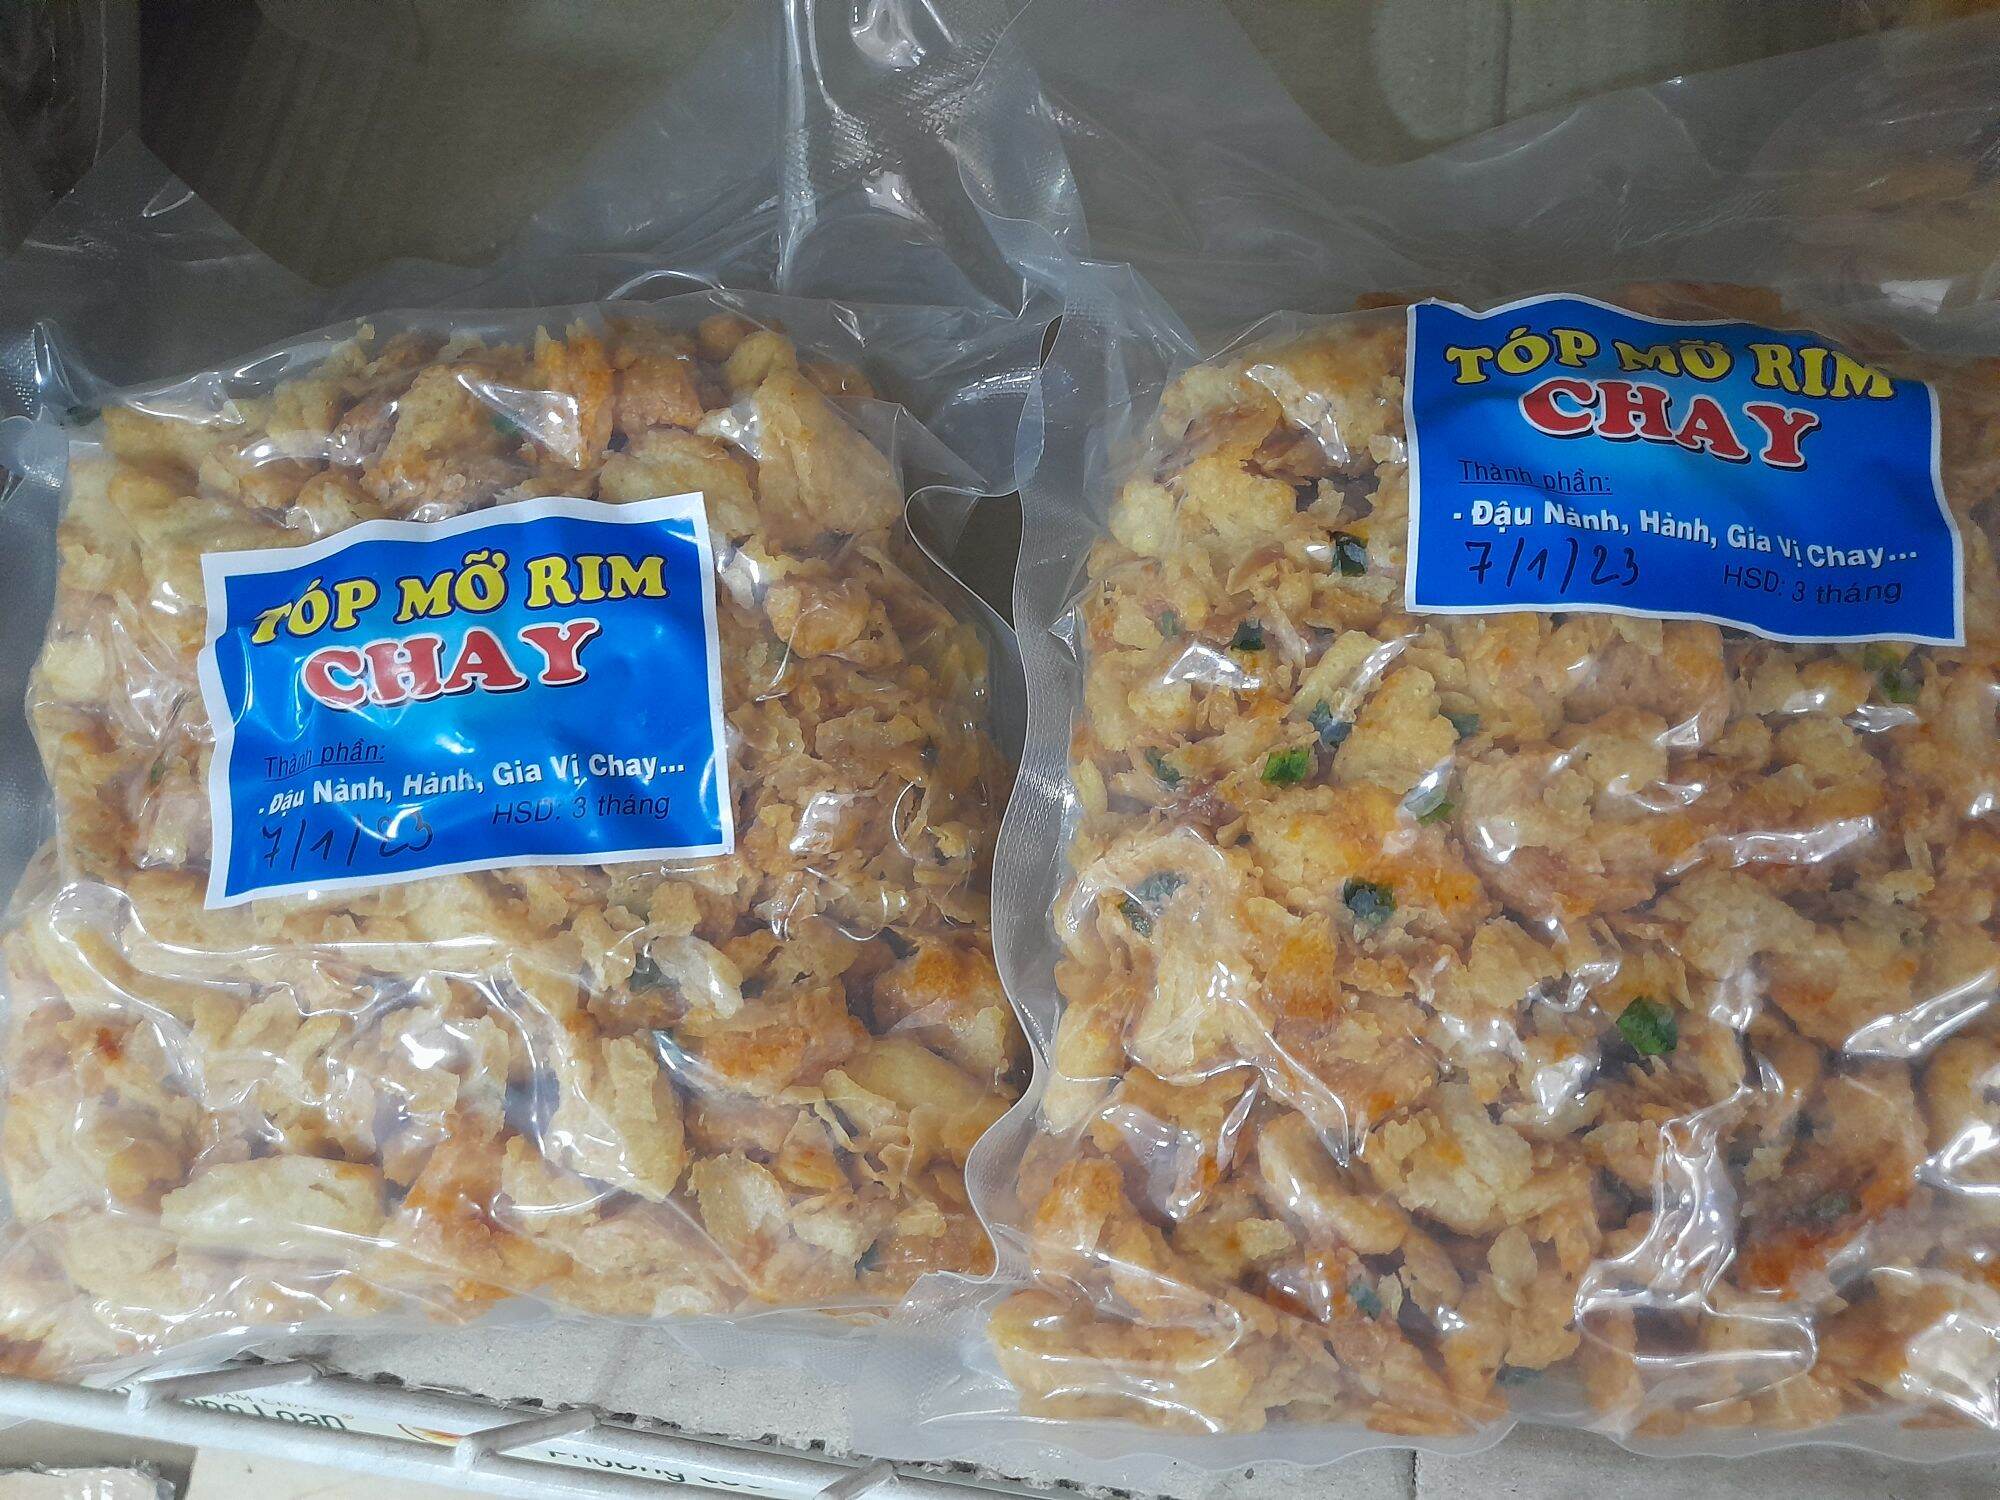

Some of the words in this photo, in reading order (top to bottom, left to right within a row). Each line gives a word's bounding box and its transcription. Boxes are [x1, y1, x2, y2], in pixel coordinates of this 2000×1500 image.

[1445, 325, 1600, 385] TÓP
[1748, 342, 1896, 400] RIM
[1518, 376, 1823, 472] CHAY
[1458, 459, 1534, 485] Thành
[1543, 468, 1614, 495] phần:
[1471, 500, 1533, 534] Đậu
[1544, 501, 1630, 536] Nành,
[1640, 509, 1717, 549] Hành,
[1727, 524, 1772, 552] Gia
[1776, 535, 1804, 568] Vị
[251, 576, 381, 645] TÓP
[395, 549, 509, 624] MỠ
[525, 554, 670, 610] RIM
[1723, 564, 1786, 597] HSD:
[1791, 580, 1806, 603] 3
[1815, 581, 1903, 605] tháng
[302, 618, 602, 709] CHAY
[264, 748, 314, 781] Thành
[320, 738, 386, 764] phần:
[268, 788, 305, 817] Đậu
[313, 776, 393, 804] Nành,
[403, 768, 484, 797] Hành,
[492, 759, 542, 786] Gia
[550, 753, 581, 785] Vị
[492, 800, 561, 825] HSD:
[572, 797, 588, 819] 3
[598, 792, 671, 820] tháng
